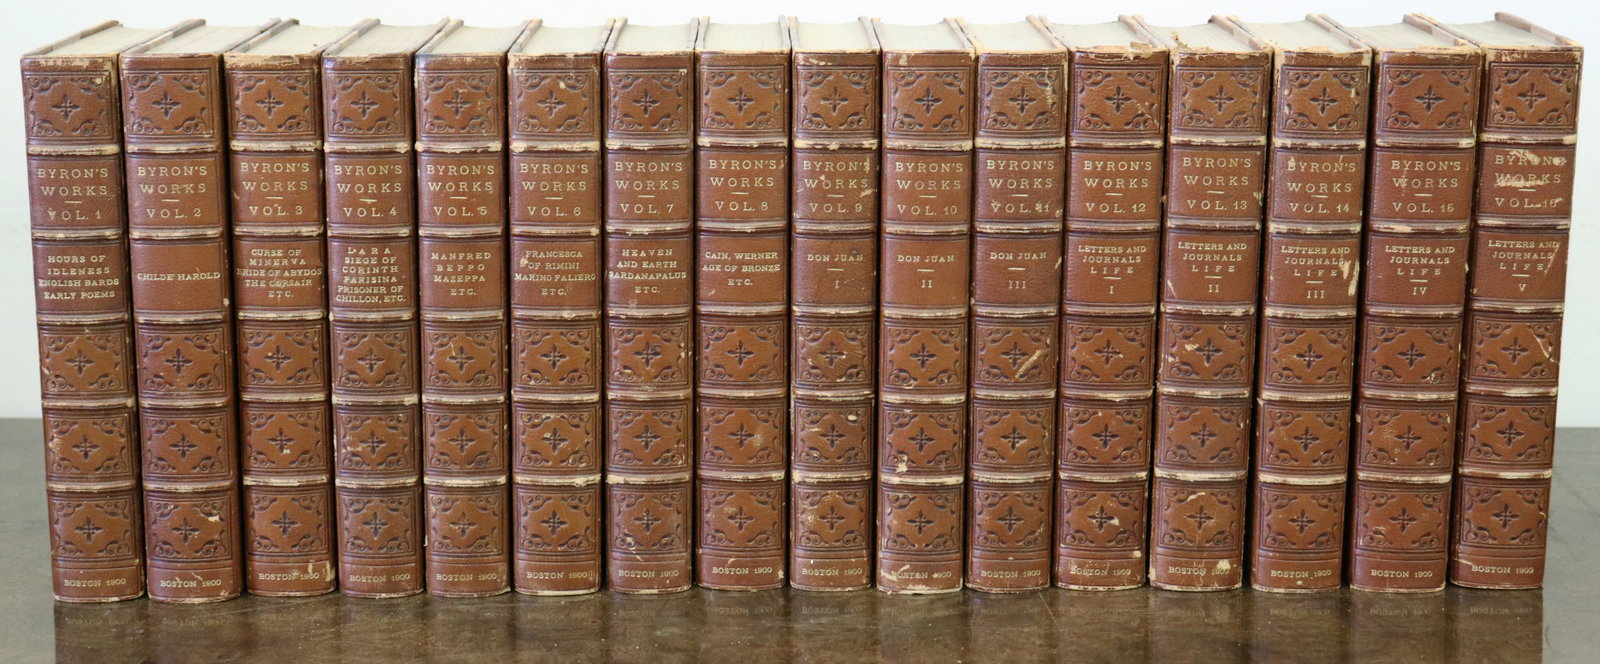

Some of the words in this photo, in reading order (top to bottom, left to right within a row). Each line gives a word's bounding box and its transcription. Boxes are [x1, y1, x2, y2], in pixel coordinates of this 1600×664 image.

[240, 162, 309, 172] BYRON'S
[615, 162, 682, 172] BYRON'S
[709, 160, 776, 170] BYRON'S
[896, 162, 963, 173] BYRON'S
[987, 160, 1054, 170] BYRON'S
[1084, 161, 1151, 171] BYRON'S
[1183, 158, 1251, 168] BYRON'S
[1391, 160, 1461, 171] BYRON'S
[38, 168, 108, 178] BYRON'S
[137, 166, 207, 176] BYRON'S
[334, 165, 402, 176] BYRON'S
[427, 165, 494, 175] BYRON'S
[520, 163, 588, 174] BYRON'S
[616, 180, 679, 190] WORKS
[710, 177, 774, 187] WORKS
[805, 179, 868, 188] WORKS
[897, 180, 961, 190] WORKS
[988, 178, 1052, 188] WORKS
[1085, 178, 1148, 188] WORKS
[1184, 176, 1248, 186] WORKS
[1392, 178, 1458, 188] WORKS
[42, 185, 107, 196] WORKS
[140, 184, 206, 194] WORKS
[242, 181, 308, 191] WORKS
[337, 183, 401, 193] WORKS
[428, 182, 492, 192] WORKS
[522, 182, 586, 191] WORKS
[1288, 183, 1351, 193] WORKS
[620, 204, 659, 213] VOL.
[667, 204, 673, 213] 7
[715, 202, 755, 211] VOL.
[761, 202, 768, 210] 8
[809, 203, 849, 212] VOL.
[855, 203, 862, 212] 9
[991, 203, 1031, 213] VOL.
[1085, 203, 1125, 213] VOL.
[1132, 203, 1146, 212] 12
[1188, 200, 1227, 210] VOL.
[1233, 201, 1247, 209] 13
[1290, 203, 1329, 213] VOL.
[1336, 203, 1349, 212] 14
[1393, 203, 1433, 213] VOL.
[147, 208, 187, 218] VOL.
[193, 208, 202, 217] 2
[249, 206, 289, 216] VOL.
[296, 206, 303, 215] 3
[343, 208, 383, 217] VOL.
[390, 207, 397, 216] 4
[433, 207, 473, 216] VOL.
[479, 207, 487, 215] 5
[528, 207, 567, 216] VOL.
[574, 207, 581, 216] 6
[898, 205, 937, 215] VOL.
[944, 206, 957, 215] 10
[48, 210, 88, 220] VOL.
[96, 210, 101, 219] 1
[1178, 242, 1223, 250] LETTERS
[1488, 240, 1534, 248] LETTERS
[288, 249, 301, 257] OF
[1078, 245, 1123, 253] LETTERS
[1281, 246, 1327, 254] LETTERS
[1385, 245, 1431, 253] LETTERS
[48, 255, 85, 263] HOURS
[91, 255, 106, 263] OF
[705, 252, 731, 260] CAIN,
[990, 252, 1012, 260] DON
[249, 258, 306, 266] MINERVA
[1285, 257, 1344, 265] JOURNALS
[343, 266, 398, 274] CORINTH
[742, 264, 780, 272] BRONZE
[1500, 262, 1543, 270] LIFE
[48, 267, 110, 275] IDLENESS
[268, 269, 281, 277] OF
[283, 267, 322, 276] ABYDOS
[609, 271, 686, 279] SARDANAPALUS
[137, 273, 174, 281] CHILDE
[177, 272, 221, 280] HAROLD
[515, 273, 552, 281] MARINO
[39, 278, 81, 287] ENGLISH
[84, 278, 119, 286] BARDS
[245, 279, 267, 287] THE
[921, 280, 933, 288] II
[1008, 280, 1026, 288] III
[1109, 286, 1114, 294] I
[1412, 287, 1427, 295] IV
[1519, 284, 1526, 292] V
[44, 291, 76, 299] EARLY
[81, 290, 115, 298] POEMS
[268, 290, 294, 298] ETC.
[1307, 290, 1325, 298] III
[336, 295, 382, 303] CHILLON,
[618, 570, 655, 578] BOSTON
[712, 567, 749, 575] BOSTON
[802, 568, 839, 576] BOSTON
[1169, 567, 1206, 575] BOSTON
[1271, 570, 1308, 578] BOSTON
[1371, 569, 1409, 578] BOSTON
[1471, 565, 1511, 574] BOSTON
[350, 575, 386, 583] BOSTON
[436, 573, 472, 581] BOSTON
[160, 580, 196, 588] BOSTON
